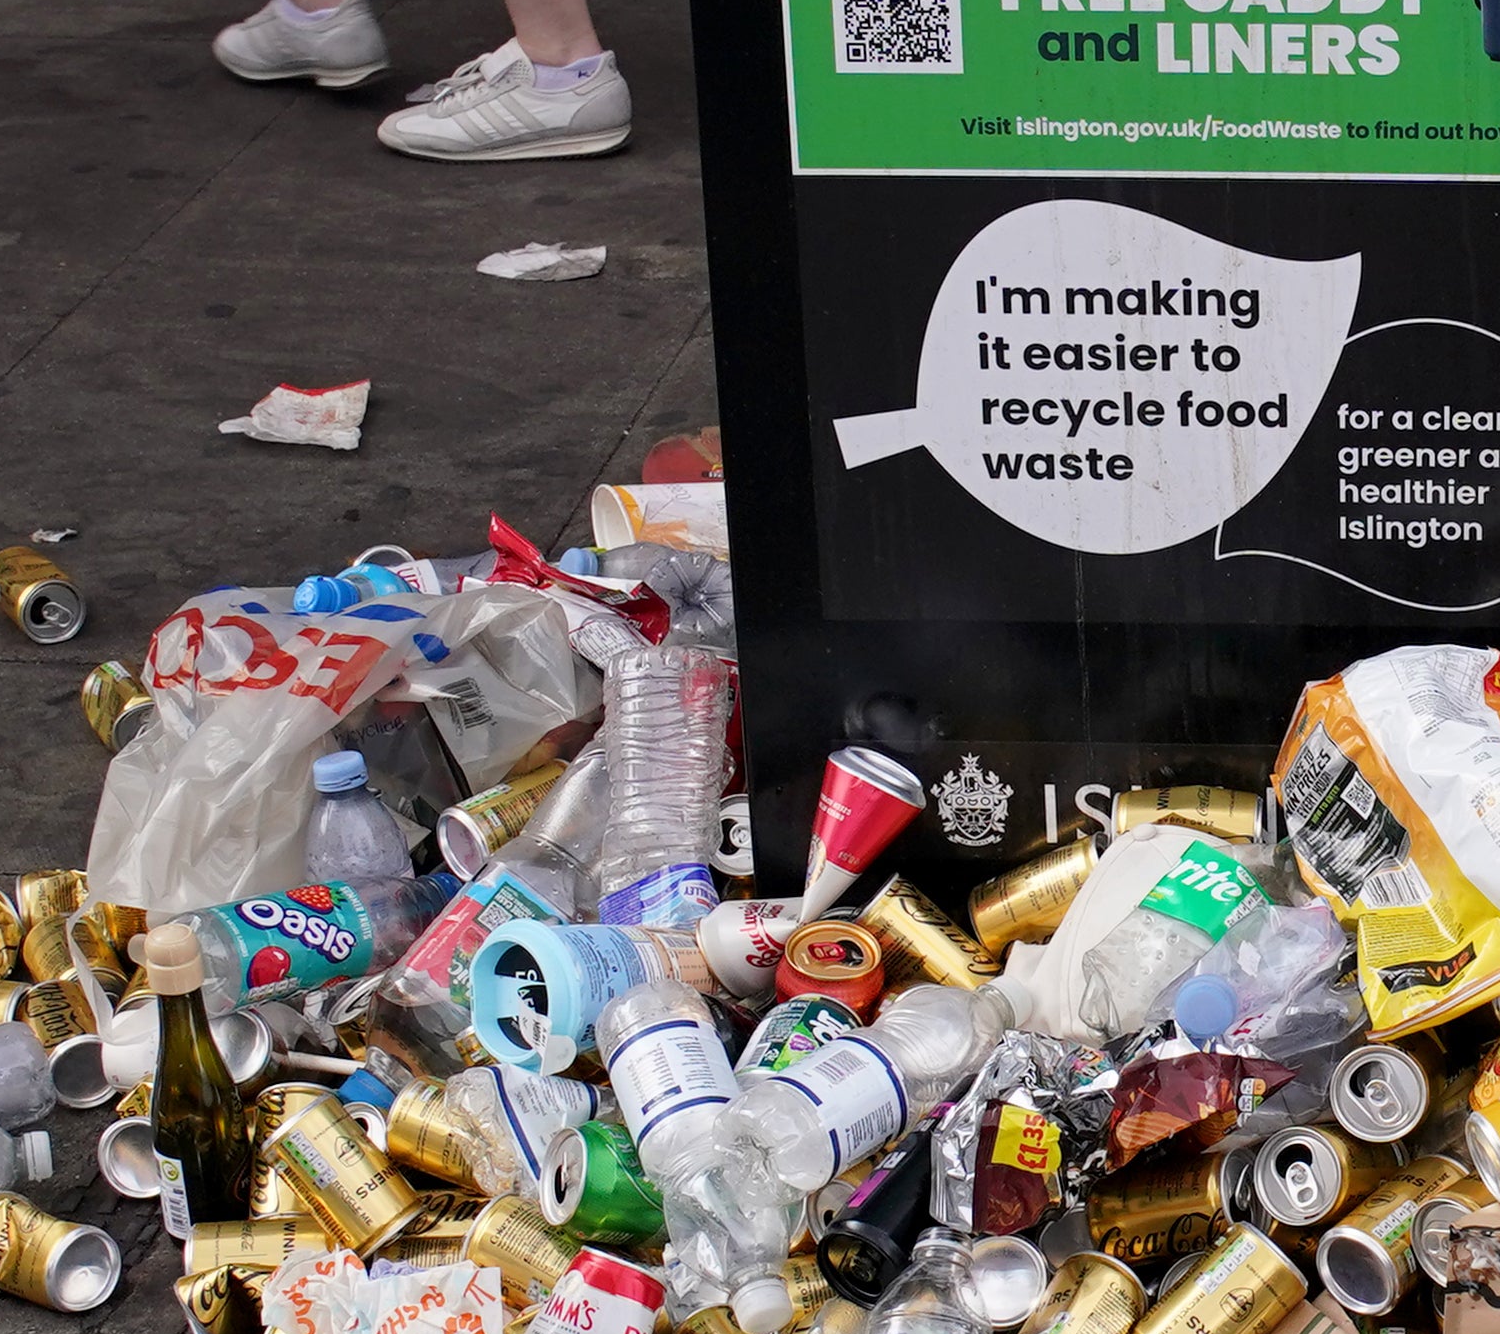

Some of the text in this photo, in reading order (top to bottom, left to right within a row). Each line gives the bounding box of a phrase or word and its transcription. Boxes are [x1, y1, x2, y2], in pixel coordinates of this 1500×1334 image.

[1037, 22, 1401, 76] and LINERS
[960, 116, 1012, 136] Visit
[1015, 114, 1342, 143] islington.gov.uk/FoodWaste
[1345, 122, 1370, 139] to
[1374, 120, 1419, 141] find
[1424, 123, 1464, 140] out
[976, 275, 1260, 330] I'm making
[977, 331, 1241, 373] it easier to
[981, 390, 1288, 438] recycle food
[1337, 403, 1384, 430] for
[1391, 410, 1413, 431] a
[981, 447, 1134, 481] waste
[1337, 446, 1471, 475] greener
[1339, 478, 1490, 505] healthier
[1339, 514, 1483, 549] Islington
[1301, 749, 1332, 798] PRIZES
[1167, 858, 1243, 902] rite
[241, 898, 357, 962] Oasis
[1427, 952, 1469, 983] VUE
[1017, 1114, 1049, 1169] £1.35
